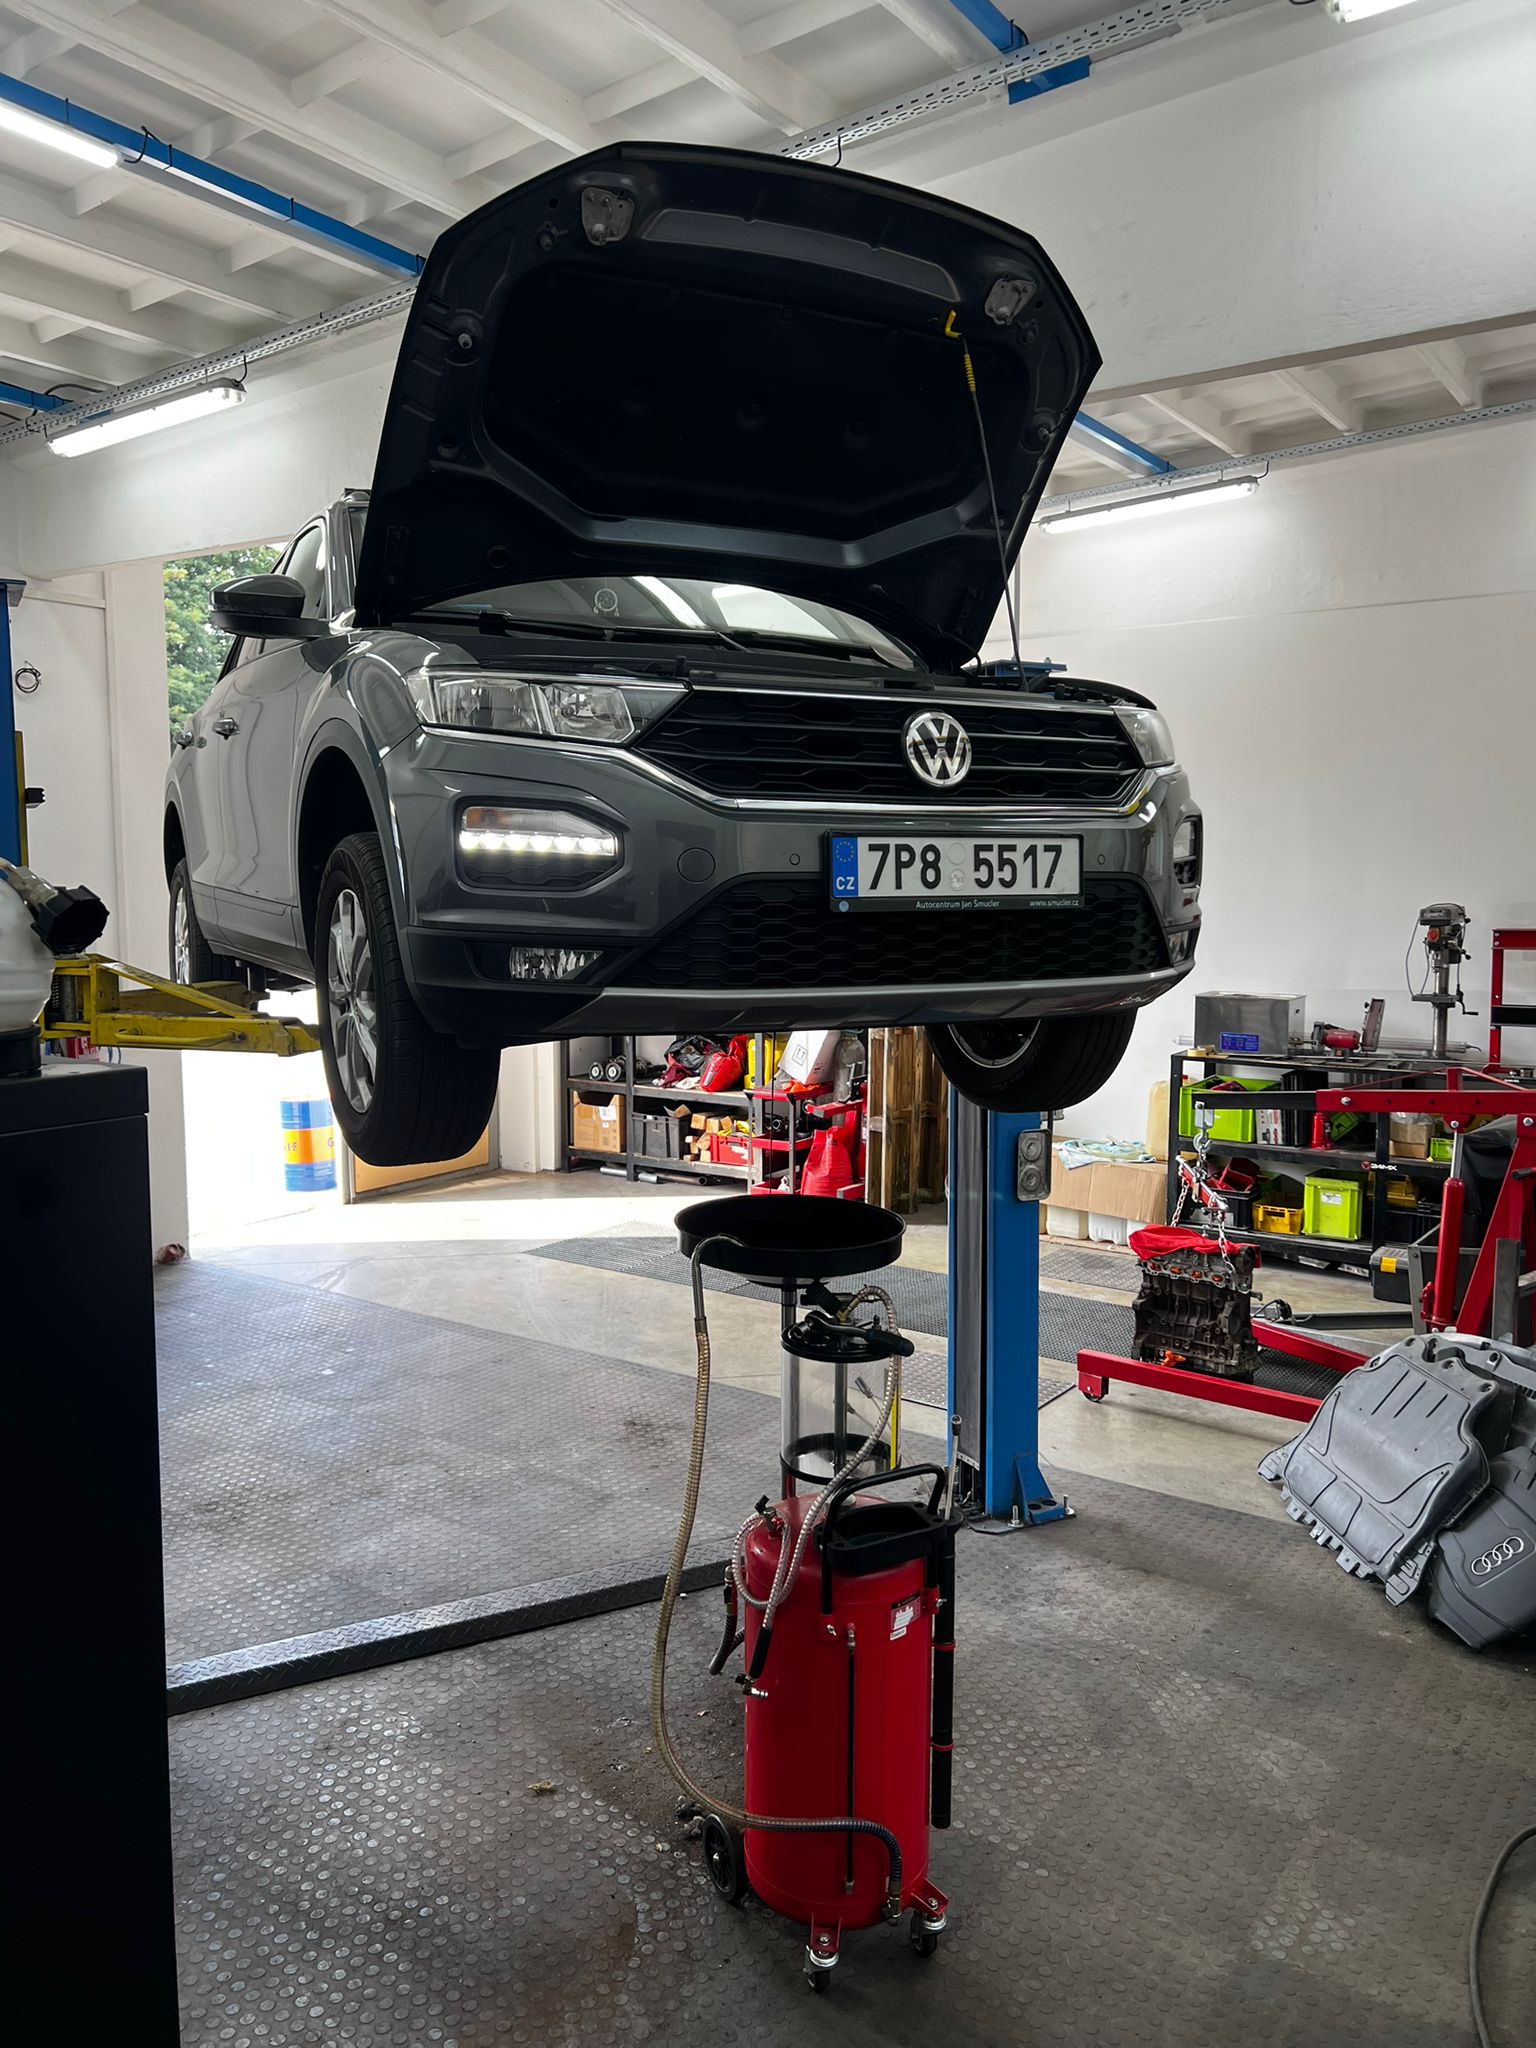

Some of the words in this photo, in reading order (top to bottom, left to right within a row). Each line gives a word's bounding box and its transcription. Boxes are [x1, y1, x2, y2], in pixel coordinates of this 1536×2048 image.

[908, 714, 970, 785] VW
[867, 843, 941, 890] 7P8
[973, 844, 1063, 889] 5517
[835, 876, 855, 891] CZ
[915, 900, 960, 909] Autocentrum
[961, 900, 973, 909] Jan
[973, 898, 1000, 908] Šmucler
[1029, 898, 1079, 907] www.smucler.cz
